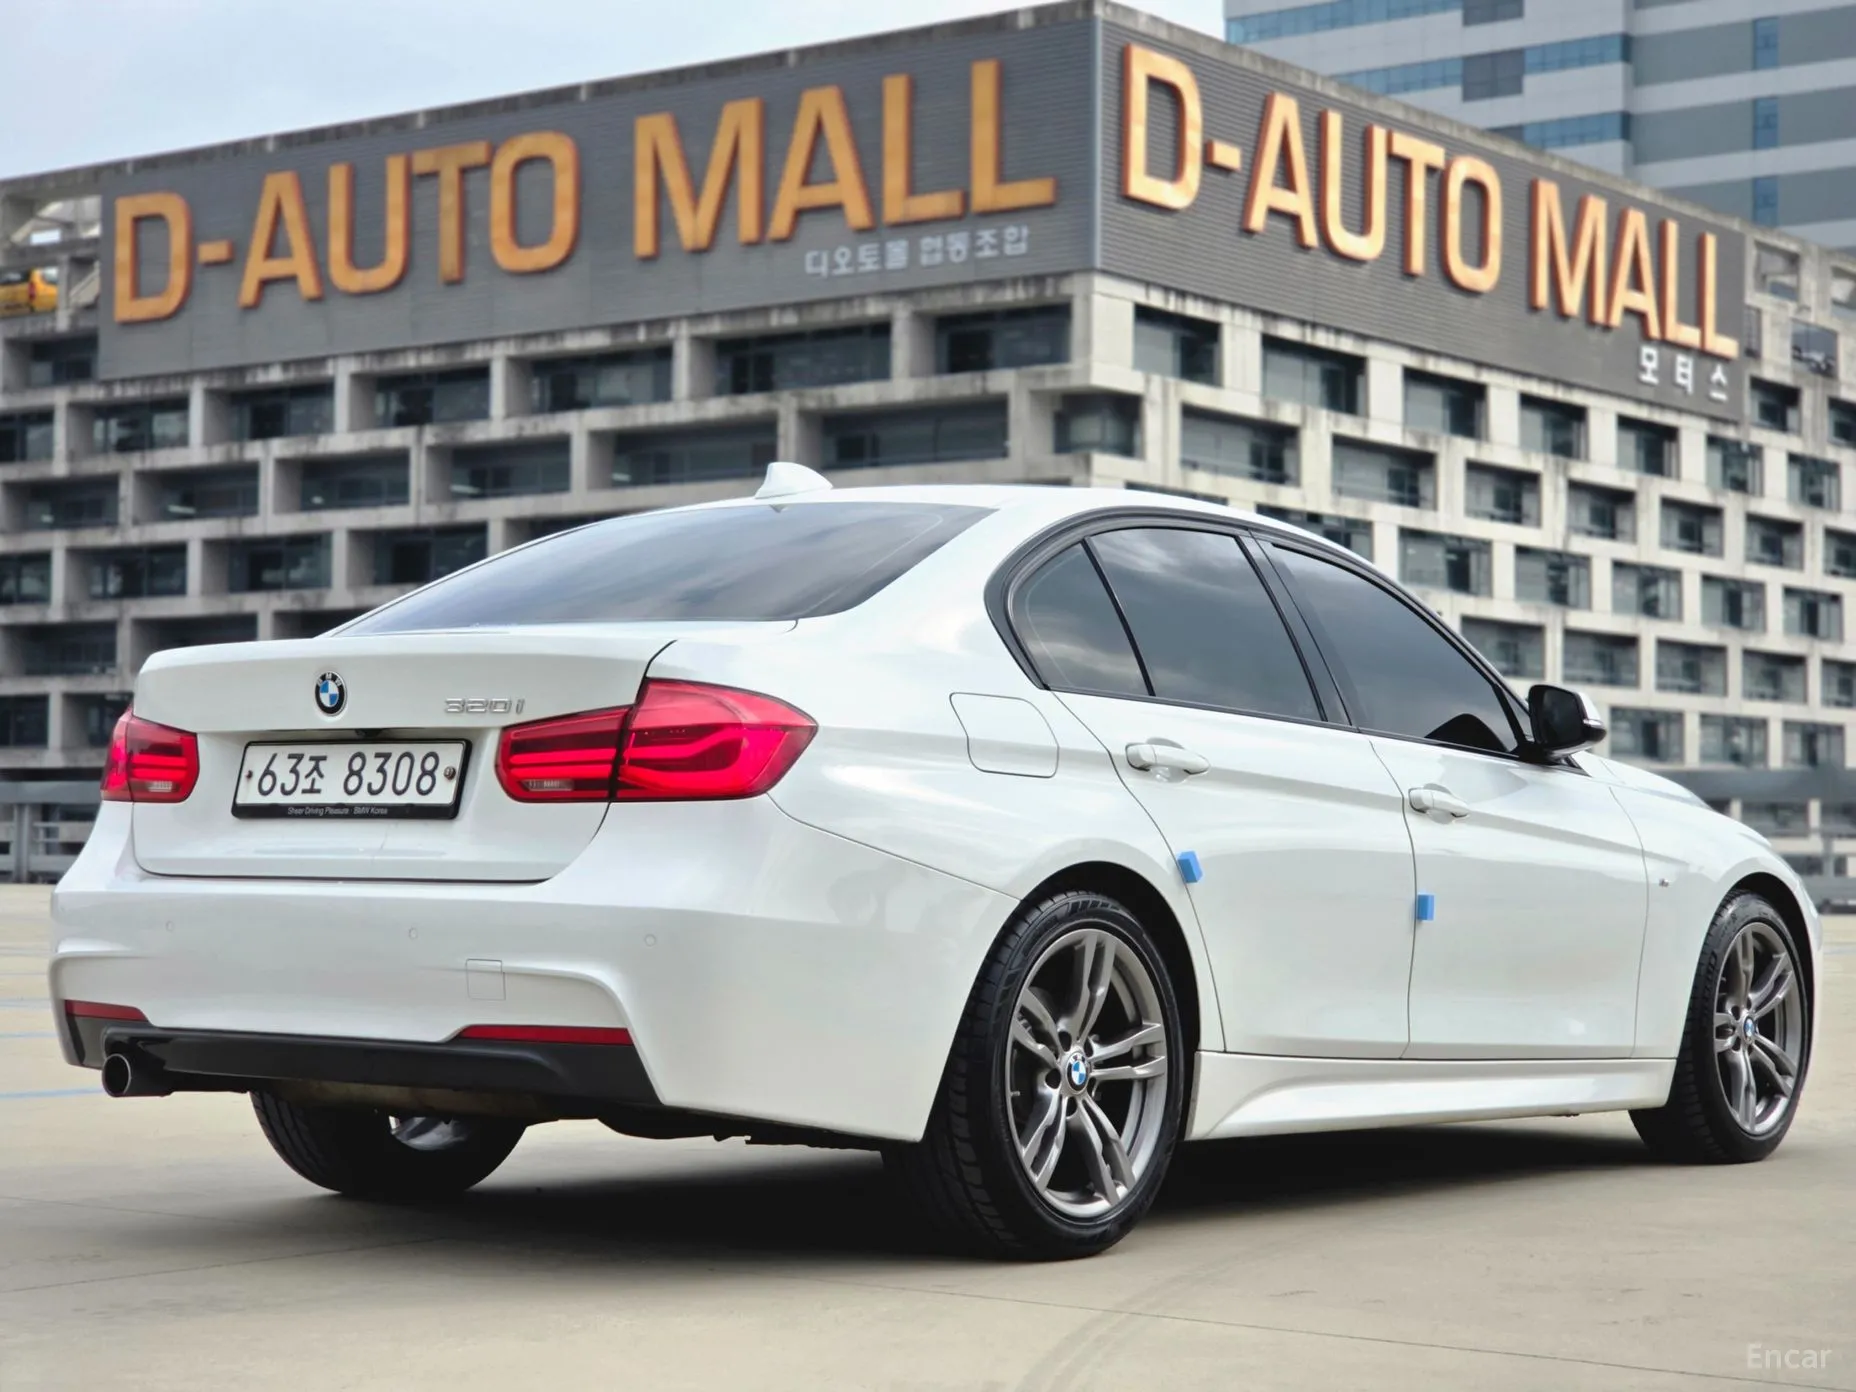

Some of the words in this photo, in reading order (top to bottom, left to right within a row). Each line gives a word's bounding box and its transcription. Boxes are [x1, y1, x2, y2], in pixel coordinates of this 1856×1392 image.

[113, 129, 581, 325] D-AUTO
[633, 57, 1057, 260] MALL
[1120, 42, 1503, 296] D-AUTO
[1530, 177, 1741, 361] MALL
[804, 239, 909, 278] 디오토몰
[920, 224, 1030, 268] 협동조합
[444, 697, 526, 715] 320i
[257, 752, 328, 797] 63조
[343, 751, 440, 797] 8308
[304, 806, 324, 817] Driving
[353, 806, 370, 815] BMW
